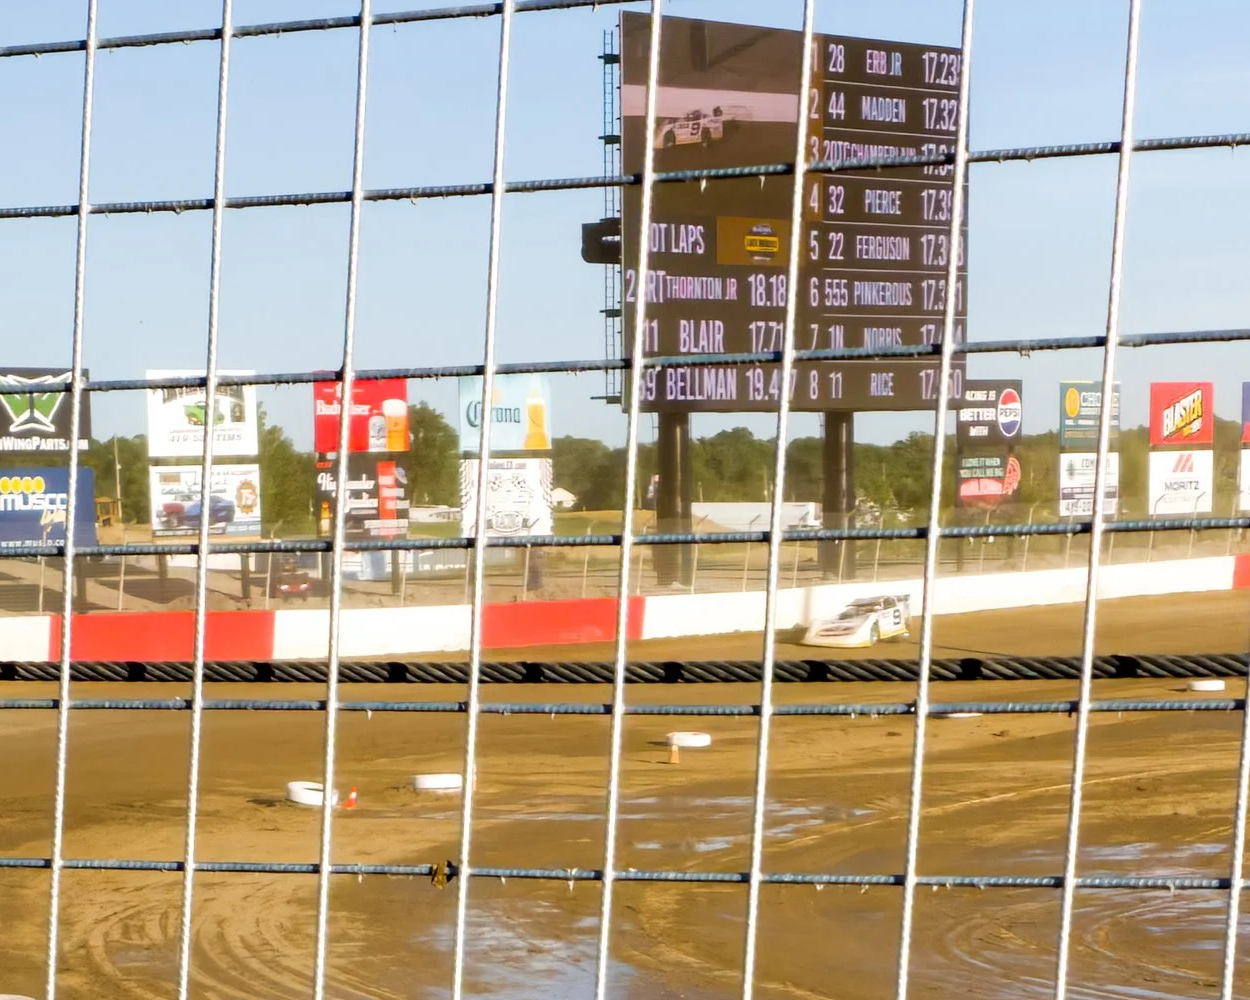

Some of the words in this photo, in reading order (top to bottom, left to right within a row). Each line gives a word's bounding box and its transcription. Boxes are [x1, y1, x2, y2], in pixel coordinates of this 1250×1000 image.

[829, 44, 845, 73] 28
[866, 50, 887, 75] ERB
[890, 52, 902, 76] JR
[810, 88, 819, 119] 2
[828, 91, 845, 120] 44
[862, 96, 906, 123] MADDEN
[810, 136, 819, 165] 3
[810, 183, 819, 214] 4
[829, 186, 845, 215] 32
[865, 189, 902, 215] PIERCE
[671, 223, 705, 254] LAPS
[810, 230, 819, 260] 5
[829, 232, 844, 260] 22
[856, 235, 910, 260] FERGUSON
[626, 269, 666, 303] 2RT
[666, 276, 722, 300] THORNTON
[725, 278, 738, 300] JR
[810, 277, 819, 307] 6
[825, 279, 848, 307] 555
[854, 281, 913, 306] PINKEROUS
[921, 280, 962, 311] 17.31
[679, 320, 724, 353] BLAIR
[810, 324, 819, 351] 7
[864, 328, 902, 350] NORRIS
[666, 368, 737, 400] BELLMAN
[746, 368, 797, 401] 19.47
[810, 370, 818, 400] 8
[829, 372, 843, 399] 11
[870, 373, 894, 397] RICE
[316, 399, 371, 416] Budiser
[465, 400, 521, 428] Crona
[960, 408, 997, 421] BETTER
[969, 426, 989, 437] WITH
[1164, 481, 1200, 491] MORITZ
